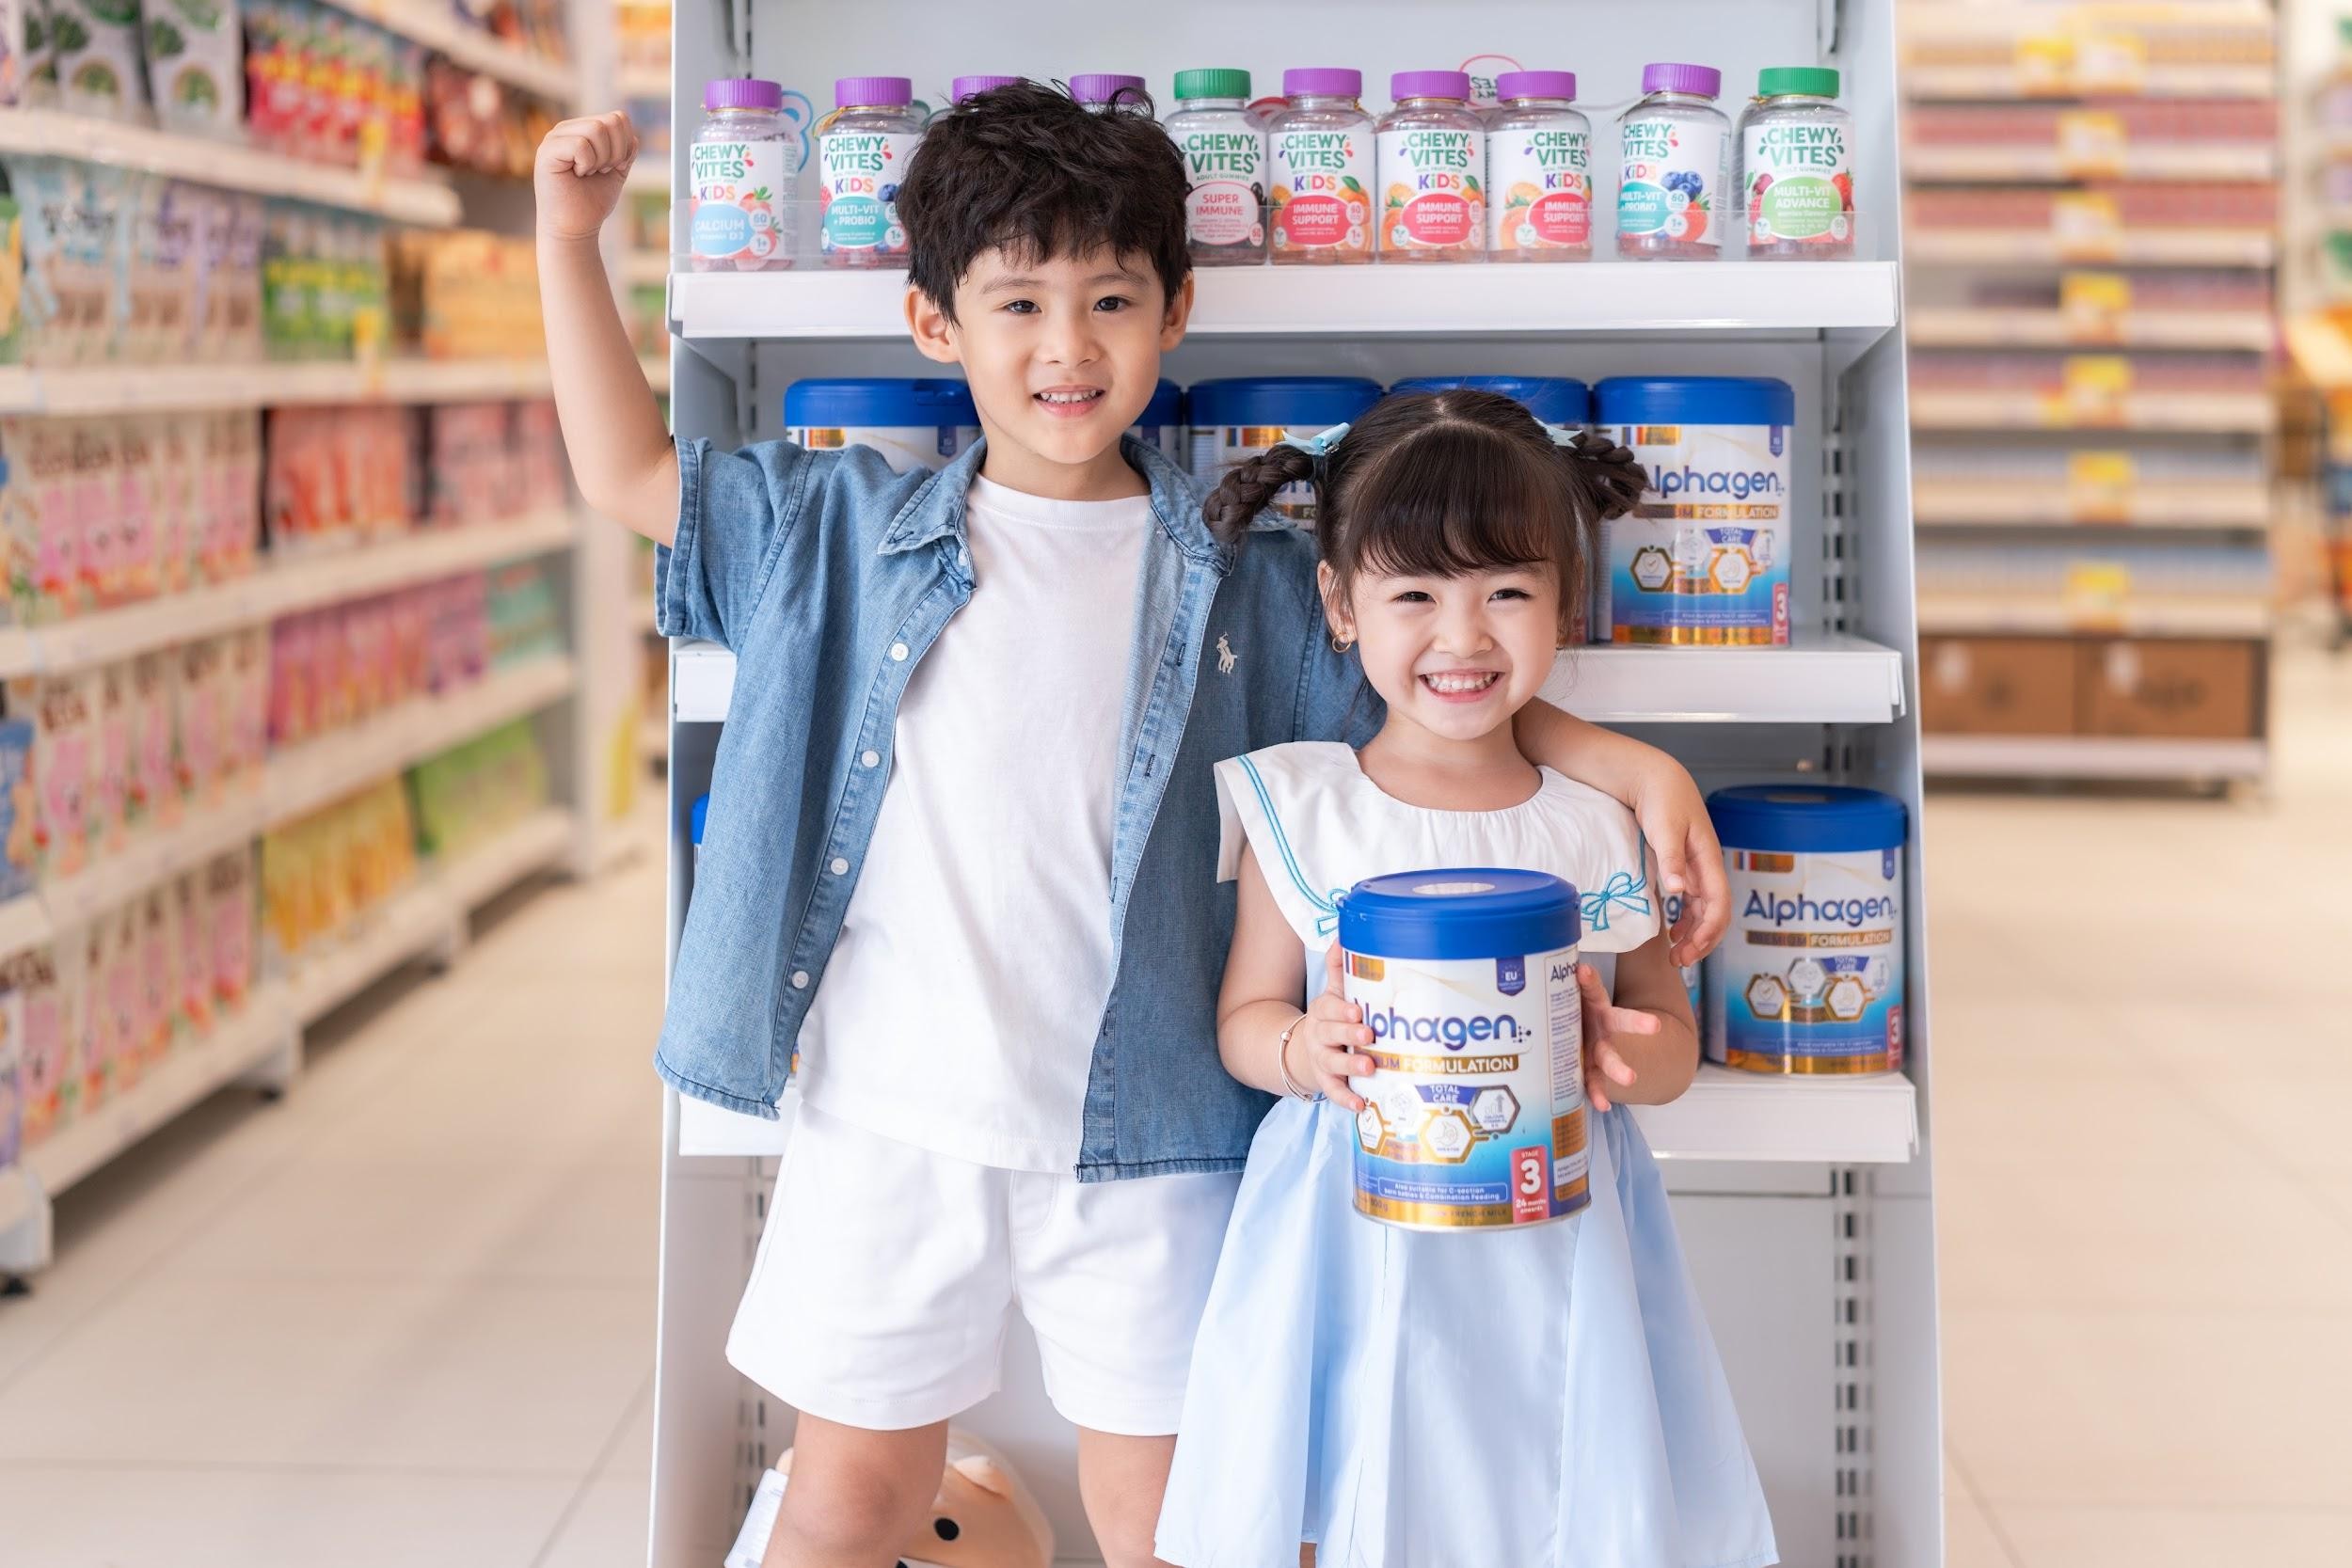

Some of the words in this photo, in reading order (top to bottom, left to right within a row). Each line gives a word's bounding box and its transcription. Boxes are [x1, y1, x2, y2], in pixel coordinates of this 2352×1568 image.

[1624, 123, 1672, 139] CHEWY
[1767, 127, 1838, 144] CHEWY
[829, 136, 885, 151] CHEWY
[1187, 134, 1255, 150] CHEWY
[1285, 134, 1347, 150] CHEWY
[1407, 133, 1469, 148] CHEWY
[1534, 132, 1588, 147] CHEWY
[694, 144, 746, 160] CHEWY
[1623, 139, 1669, 158] VITES
[830, 151, 883, 171] VITES
[1189, 152, 1254, 174] VITES
[1287, 150, 1345, 169] VITES
[1410, 149, 1469, 167] VITES
[1536, 149, 1587, 167] VITES
[1770, 146, 1836, 167] VITES
[695, 160, 745, 180] VITES
[1202, 194, 1239, 204] SUPER
[1671, 193, 1685, 202] 60
[1775, 186, 1830, 197] MULTI-VIT
[831, 204, 879, 215] MULTI-VIT
[1196, 206, 1245, 216] IMMUNE
[1293, 204, 1338, 214] IMMUNE
[1417, 202, 1462, 212] IMMUNE
[1544, 202, 1585, 212] IMMUNE
[1775, 198, 1830, 209] ADVANCE
[1292, 214, 1340, 225] SUPPORT
[1416, 213, 1463, 224] SUPPORT
[1543, 213, 1585, 223] SUPPORT
[1655, 465, 1777, 499] lphagen
[1697, 506, 1778, 518] FORMULATION
[1775, 592, 1786, 622] 3
[1743, 889, 1892, 927] Alphagen
[1810, 931, 1890, 947] FORMULATION
[1505, 972, 1517, 981] EU
[1354, 997, 1518, 1052] lphagen
[1403, 1056, 1514, 1072] FORMULATION
[1429, 1085, 1460, 1094] TOTAL
[1433, 1093, 1458, 1103] CARE
[1521, 1150, 1539, 1159] STAGE
[1520, 1158, 1542, 1195] 3
[1394, 1182, 1408, 1191] Also
[1408, 1184, 1436, 1194] suitable
[1424, 1192, 1470, 1200] Combination
[1516, 1199, 1527, 1209] 24
[1519, 1205, 1543, 1214] onwards
